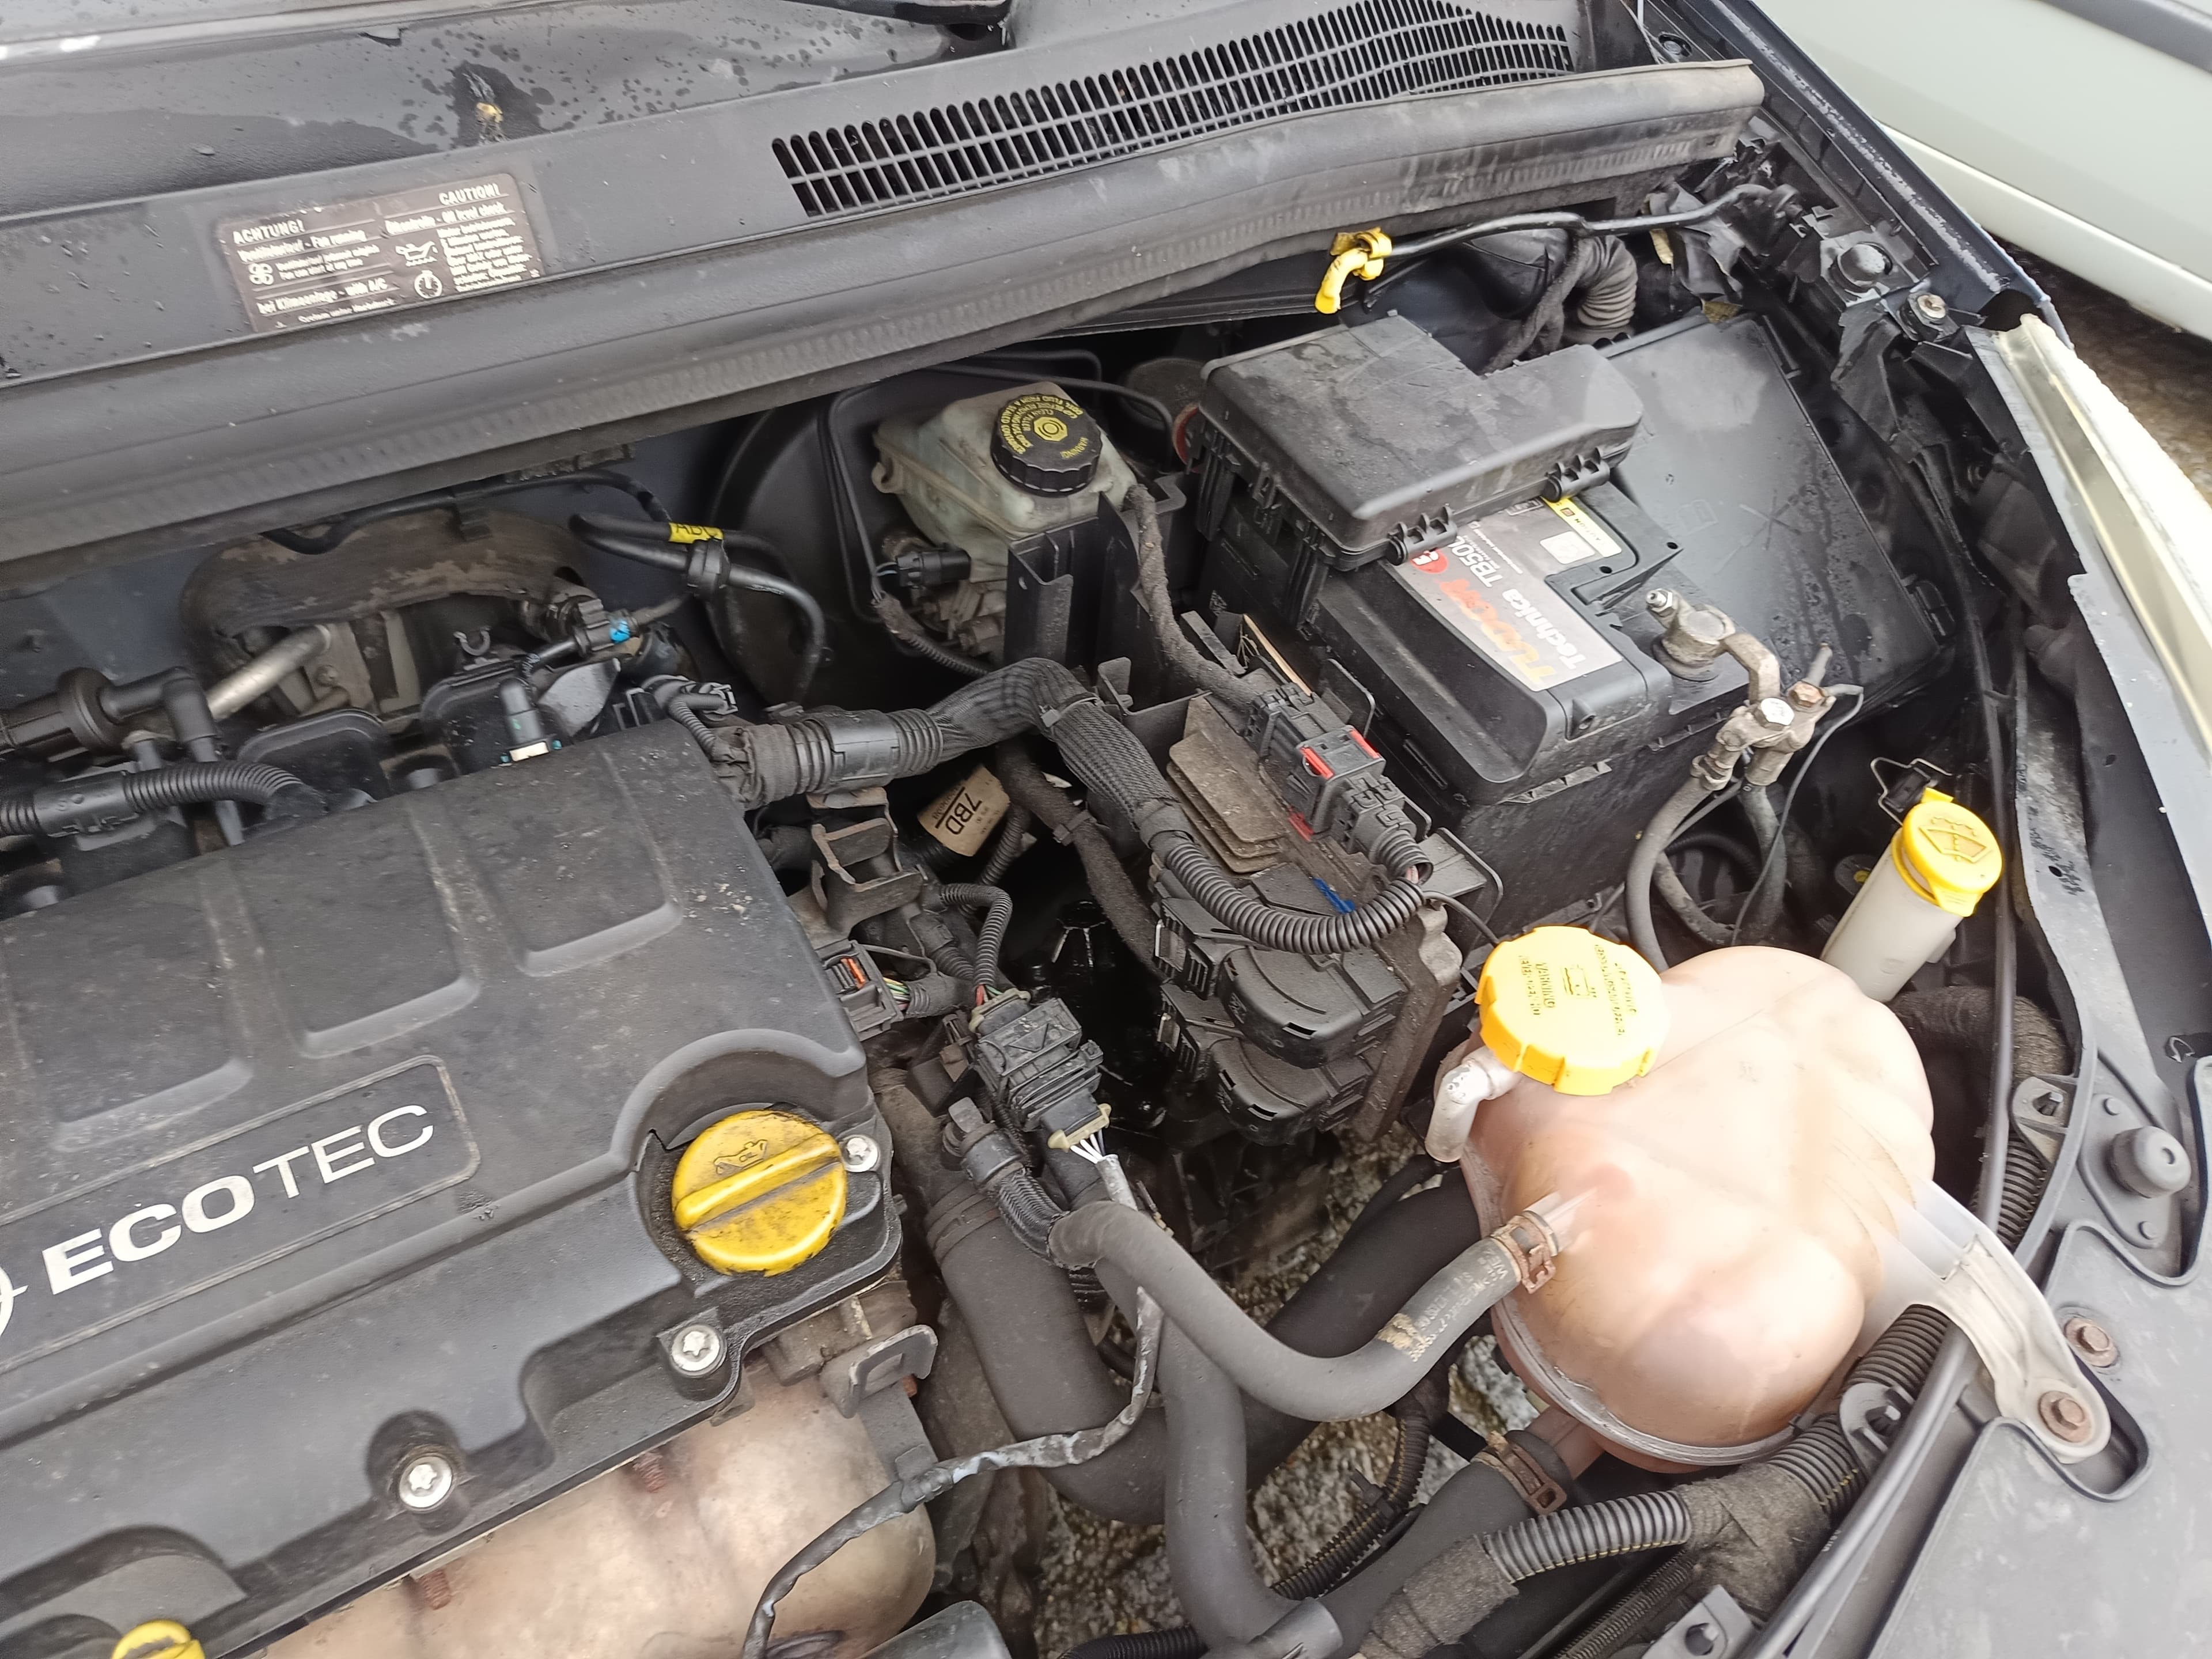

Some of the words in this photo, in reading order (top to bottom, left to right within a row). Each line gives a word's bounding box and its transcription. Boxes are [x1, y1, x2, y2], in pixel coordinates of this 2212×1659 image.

[439, 183, 501, 205] CAUTION!
[233, 219, 304, 244] ACHTUNG!
[1502, 588, 1586, 669] Technica
[945, 793, 983, 835] 7BD
[42, 1105, 434, 1296] ECOTEC
